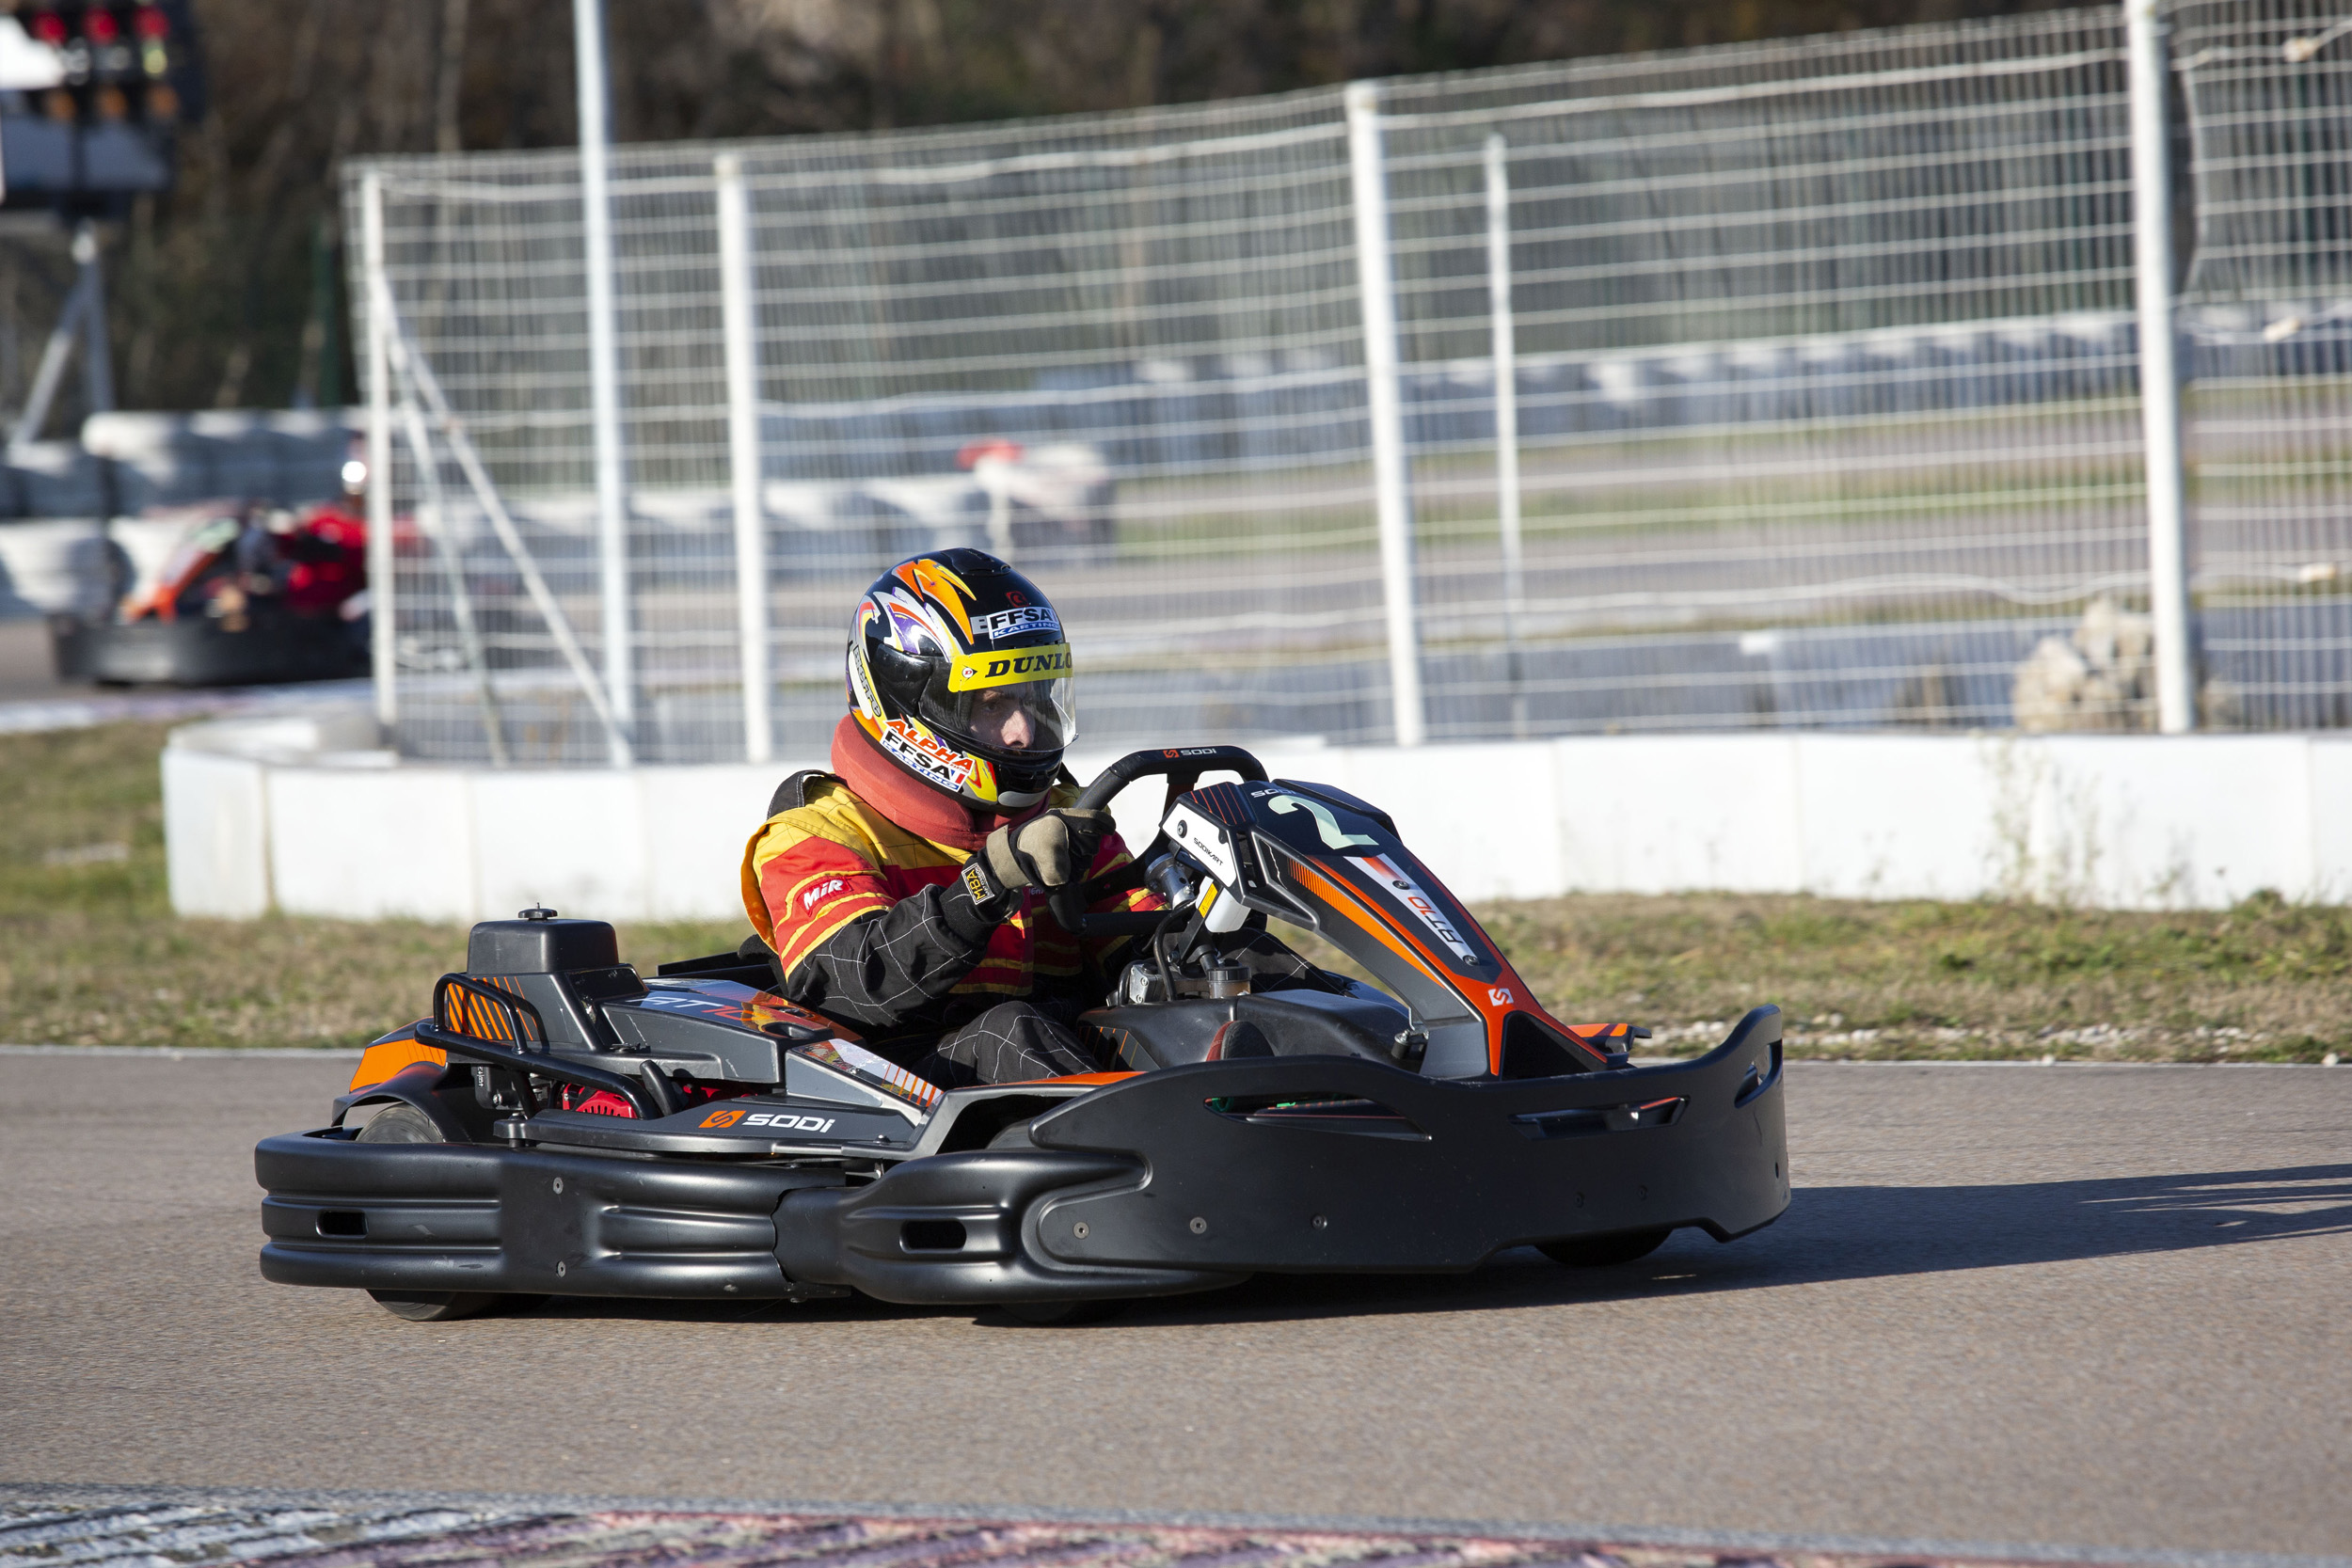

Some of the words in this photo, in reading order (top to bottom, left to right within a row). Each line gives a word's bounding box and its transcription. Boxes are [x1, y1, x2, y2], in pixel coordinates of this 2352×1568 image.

[990, 608, 1054, 629] FFSA
[993, 621, 1059, 638] KARTING
[984, 651, 1073, 678] DUNLO
[884, 730, 950, 780] FFSA
[885, 721, 974, 771] ALPHA
[1180, 748, 1217, 756] SODI
[1193, 837, 1224, 866] SODIKART
[966, 869, 986, 900] MBA
[1407, 896, 1464, 944] RT10
